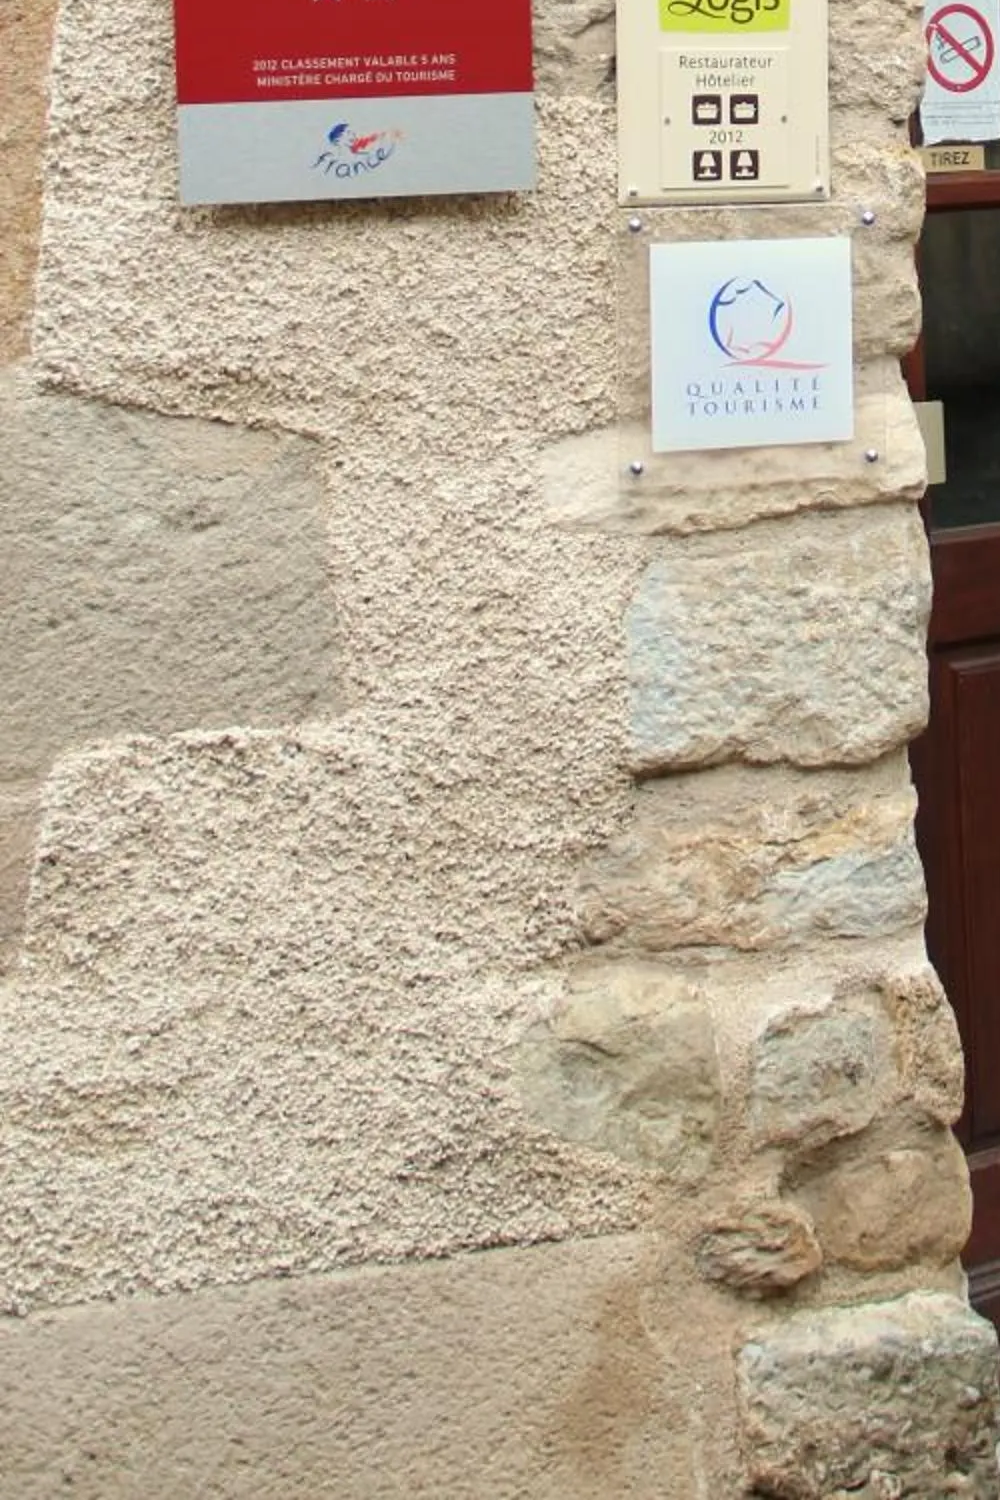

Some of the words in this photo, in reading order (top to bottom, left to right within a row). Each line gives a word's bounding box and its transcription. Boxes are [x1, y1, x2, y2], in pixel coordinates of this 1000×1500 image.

[252, 58, 278, 71] 2012
[281, 57, 360, 70] CLASSEMENT
[363, 55, 418, 68] VALABLE
[420, 54, 428, 66] 5
[431, 53, 456, 65] ANS
[678, 55, 773, 69] Restaurateur
[376, 73, 393, 83] DU
[396, 70, 456, 82] TOURISME
[695, 74, 755, 87] Hôtelier
[709, 130, 743, 144] 2012
[930, 151, 970, 167] TIREZ
[687, 397, 821, 416] TOURISME
